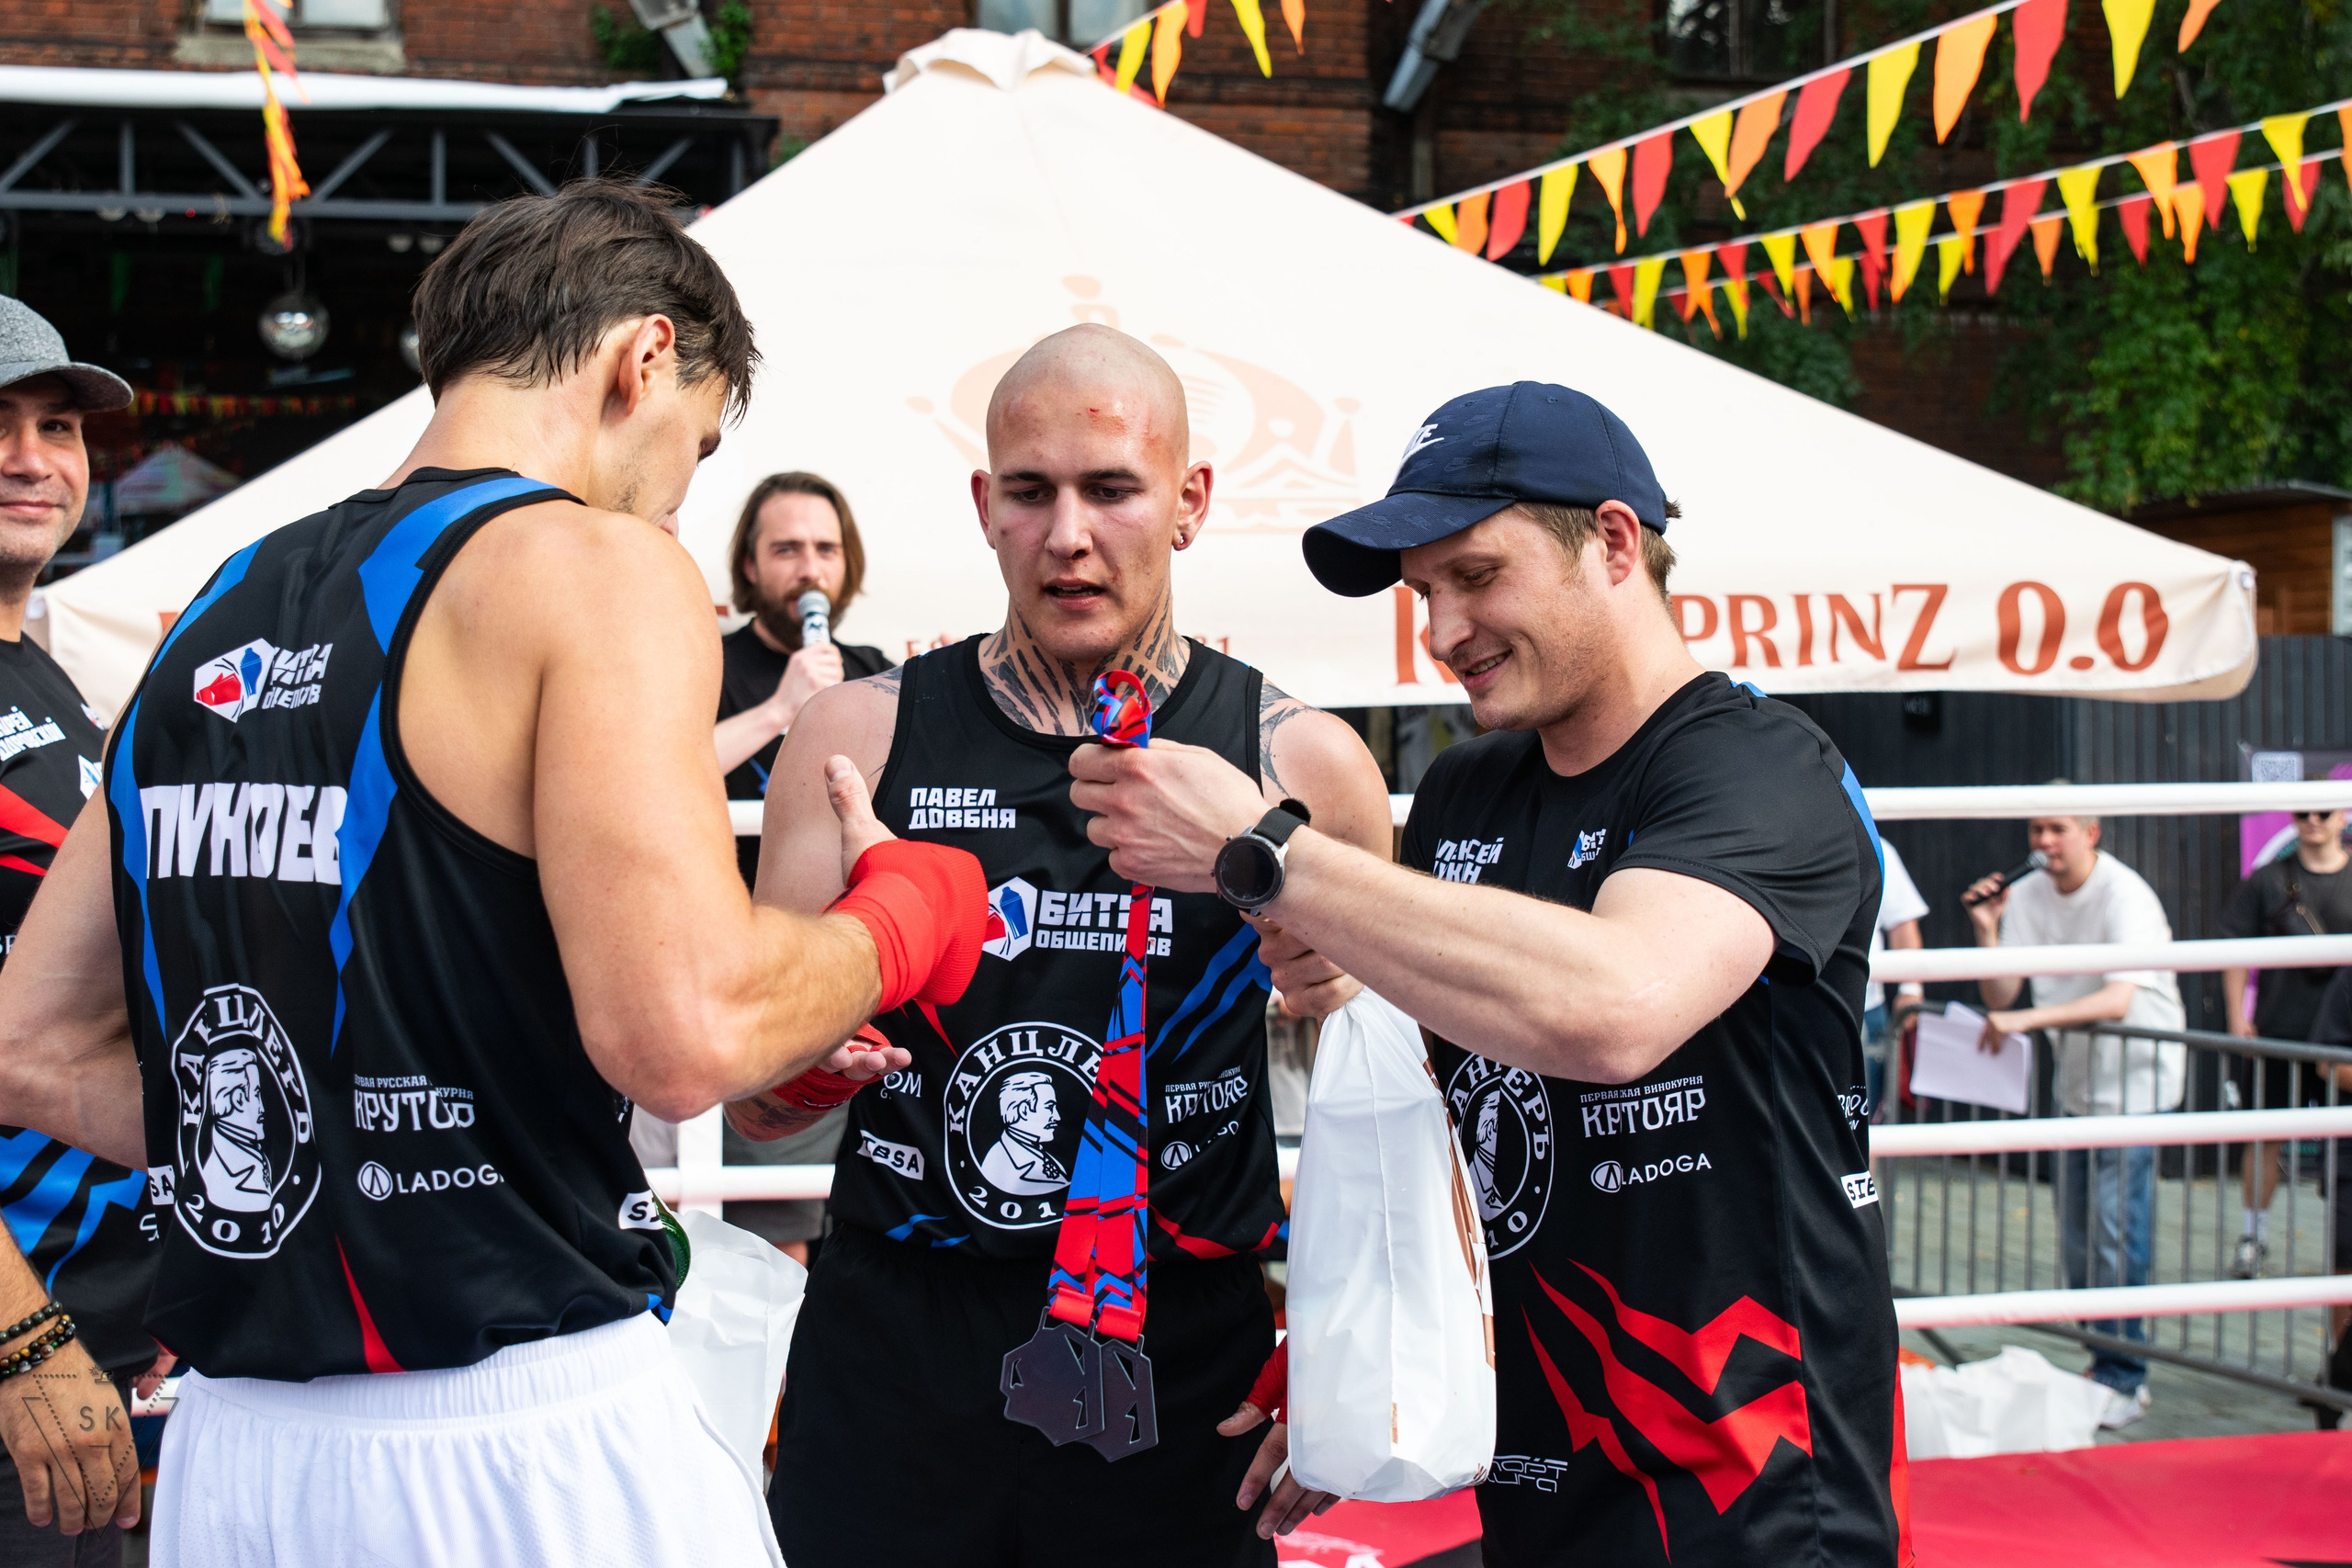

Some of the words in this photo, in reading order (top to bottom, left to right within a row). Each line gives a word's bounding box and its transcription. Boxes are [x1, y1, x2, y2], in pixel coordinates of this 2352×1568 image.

[1996, 580, 2169, 676] 0.0
[910, 787, 996, 807] ПАВЕЛ
[909, 807, 1016, 829] ДОВБНЯ
[1035, 930, 1171, 956] ОБЩЕПИОВ
[378, 1075, 427, 1089] РУССКАЯ
[434, 1088, 474, 1100] КУРНЯ
[949, 1030, 1102, 1134] КАНЦЛЕ
[1165, 1082, 1196, 1093] ПЕРВАЯ
[1580, 1090, 1618, 1103] ПЕРВАЯ
[1644, 1075, 1703, 1095] ВИНОКУРНЯ
[1581, 1088, 1706, 1138] КРТОЯР
[396, 1164, 504, 1193] LADOG
[968, 1186, 1057, 1219] 201
